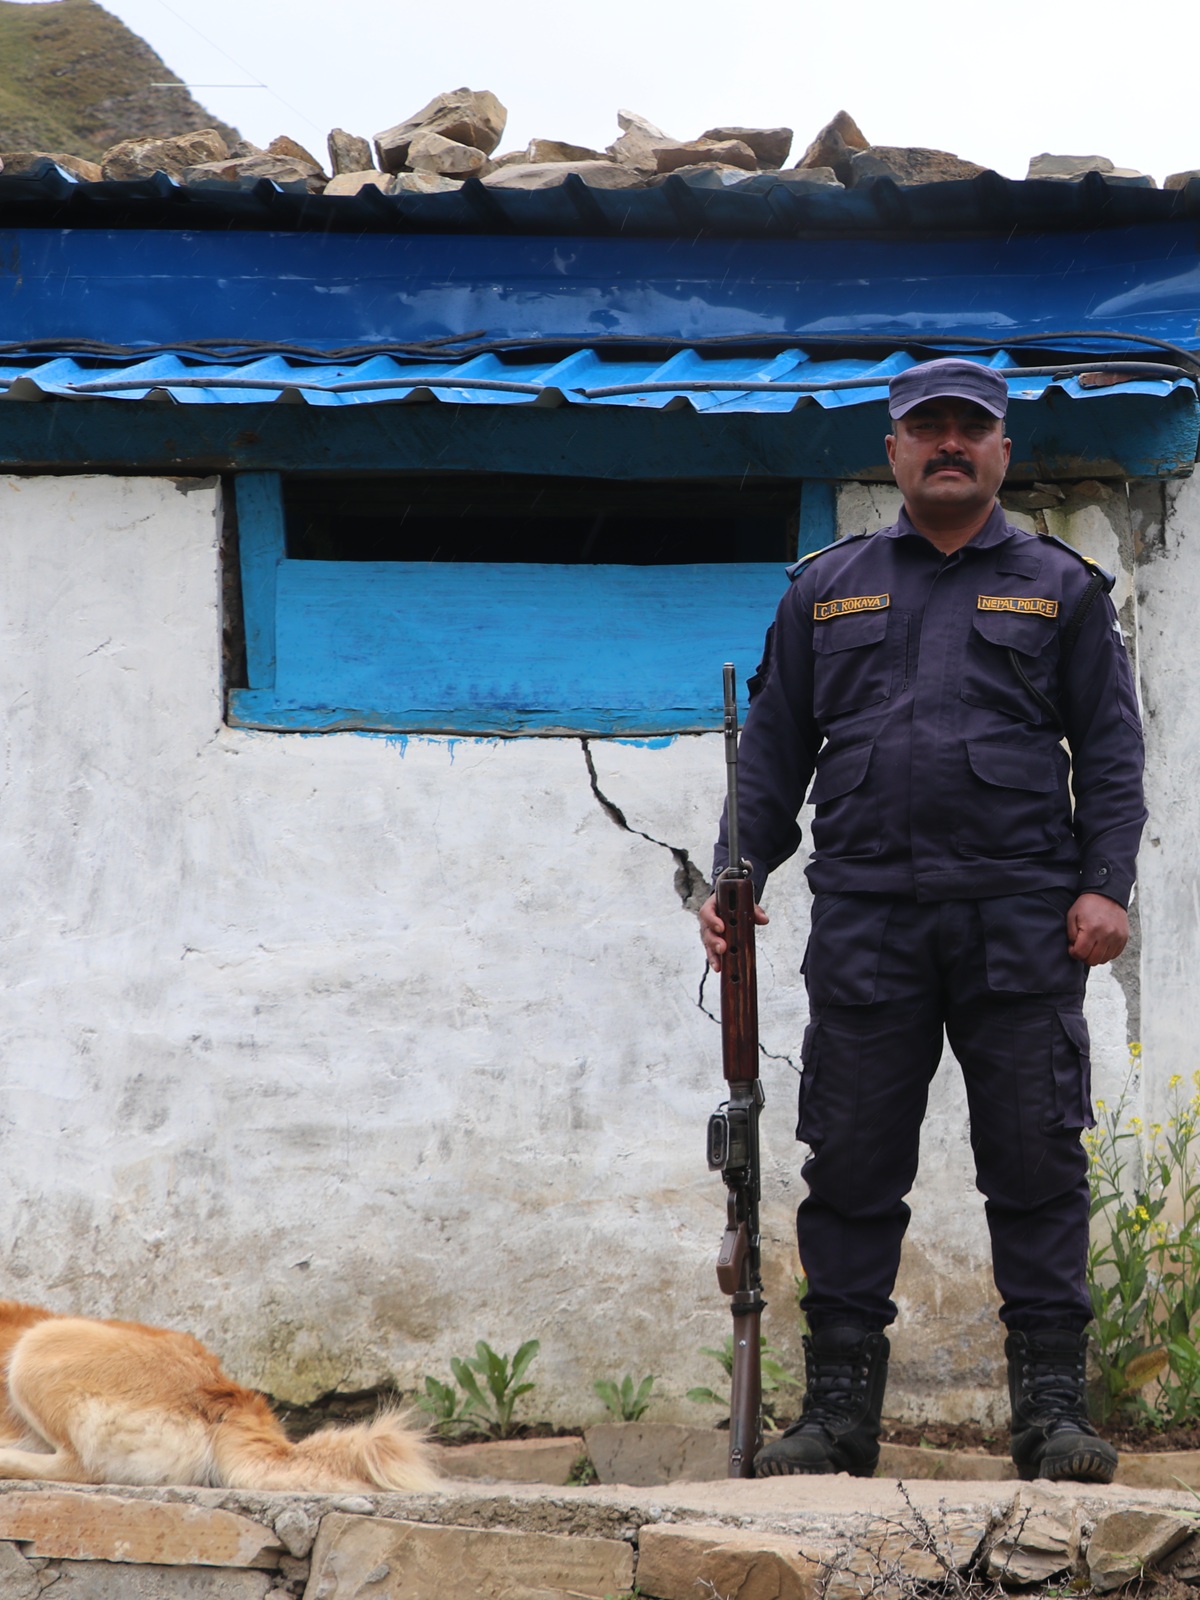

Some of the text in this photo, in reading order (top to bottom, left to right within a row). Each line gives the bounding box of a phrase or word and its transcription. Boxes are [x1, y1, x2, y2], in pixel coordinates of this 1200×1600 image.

[841, 598, 881, 612] ROKAYA
[982, 599, 1054, 614] NEPAL POLICE
